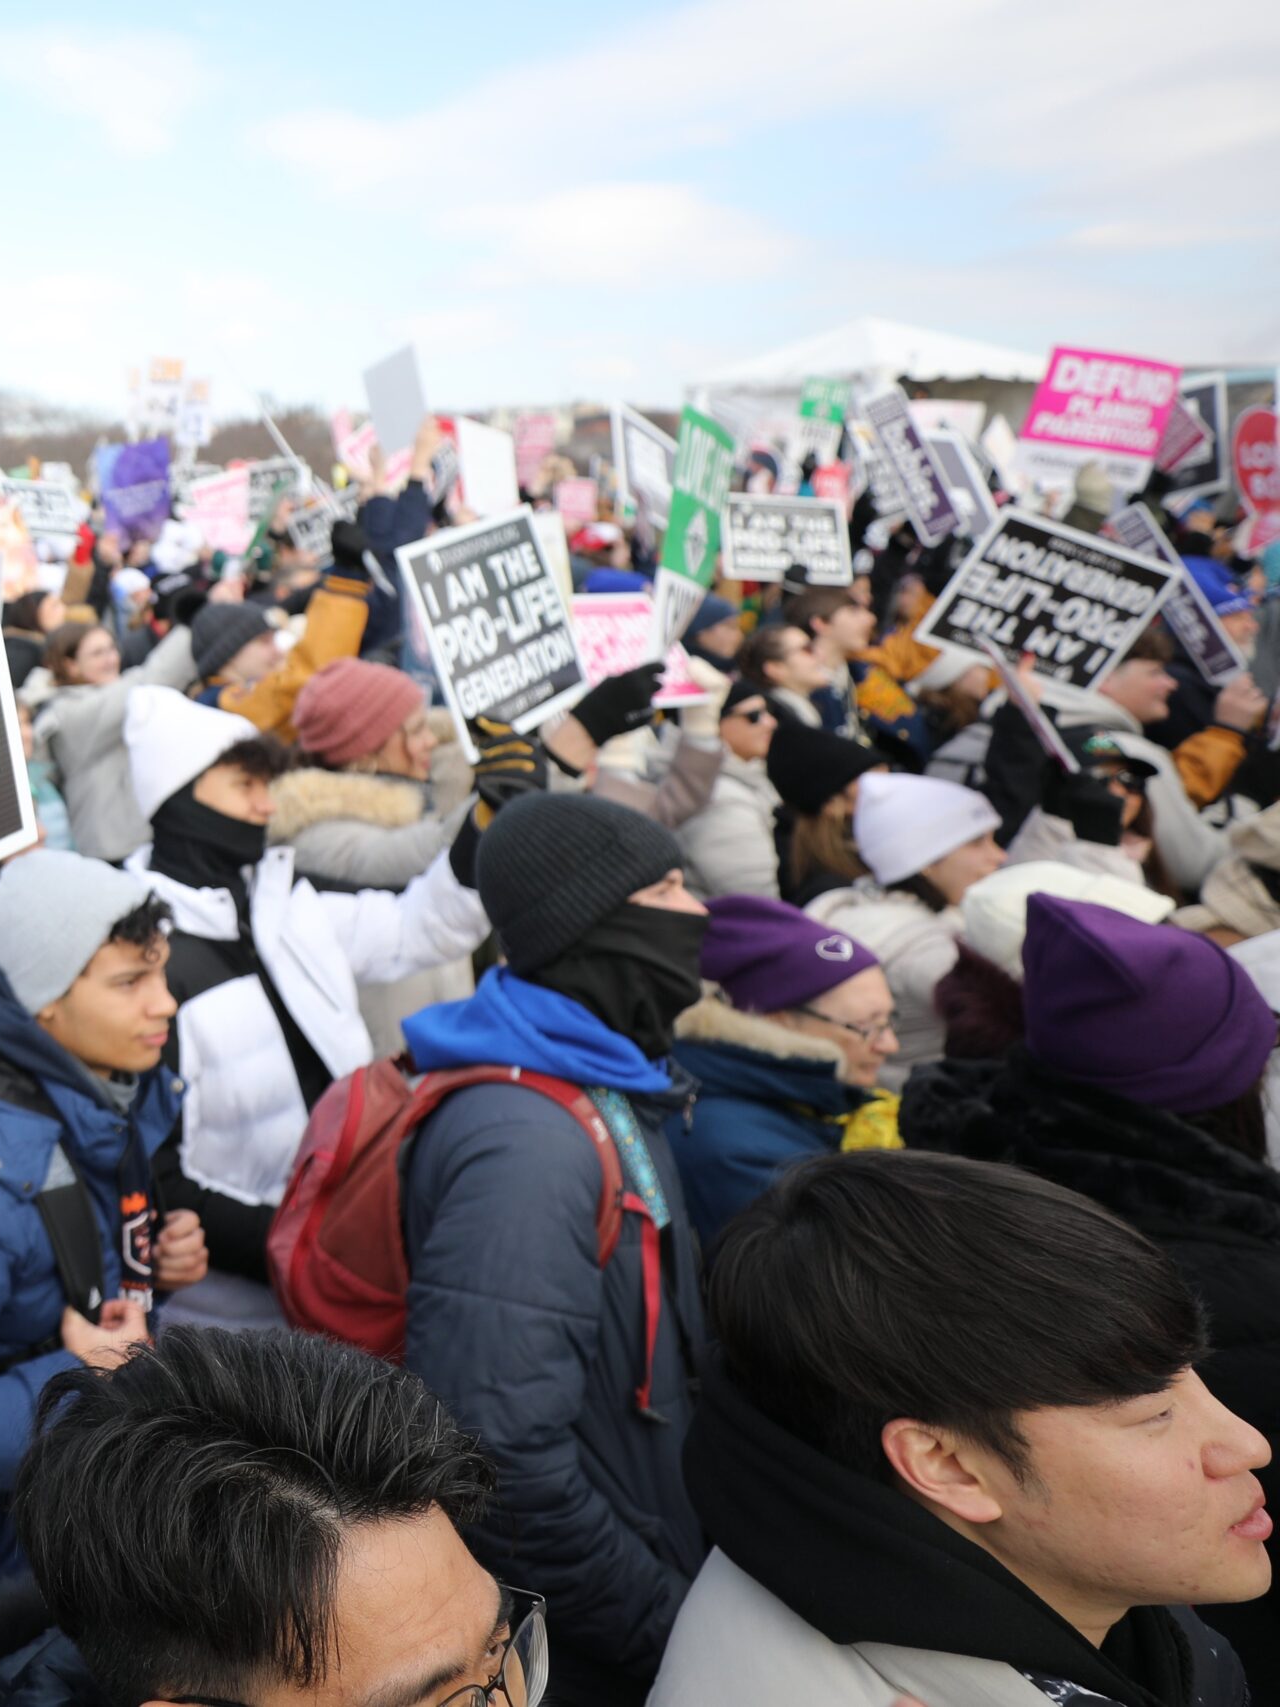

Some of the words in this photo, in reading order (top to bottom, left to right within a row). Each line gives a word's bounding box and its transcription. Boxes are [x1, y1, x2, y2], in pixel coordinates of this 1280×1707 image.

[422, 582, 441, 620] I
[444, 562, 490, 612] AM
[486, 540, 542, 590] THE
[957, 562, 1139, 650] PRO-LIFE
[984, 533, 1156, 615] GENERATION
[433, 576, 565, 677] PRO-LIFE
[947, 599, 1020, 644] THE
[1022, 625, 1087, 664] AM
[1084, 647, 1110, 674] I
[454, 624, 576, 720] GENERATION
